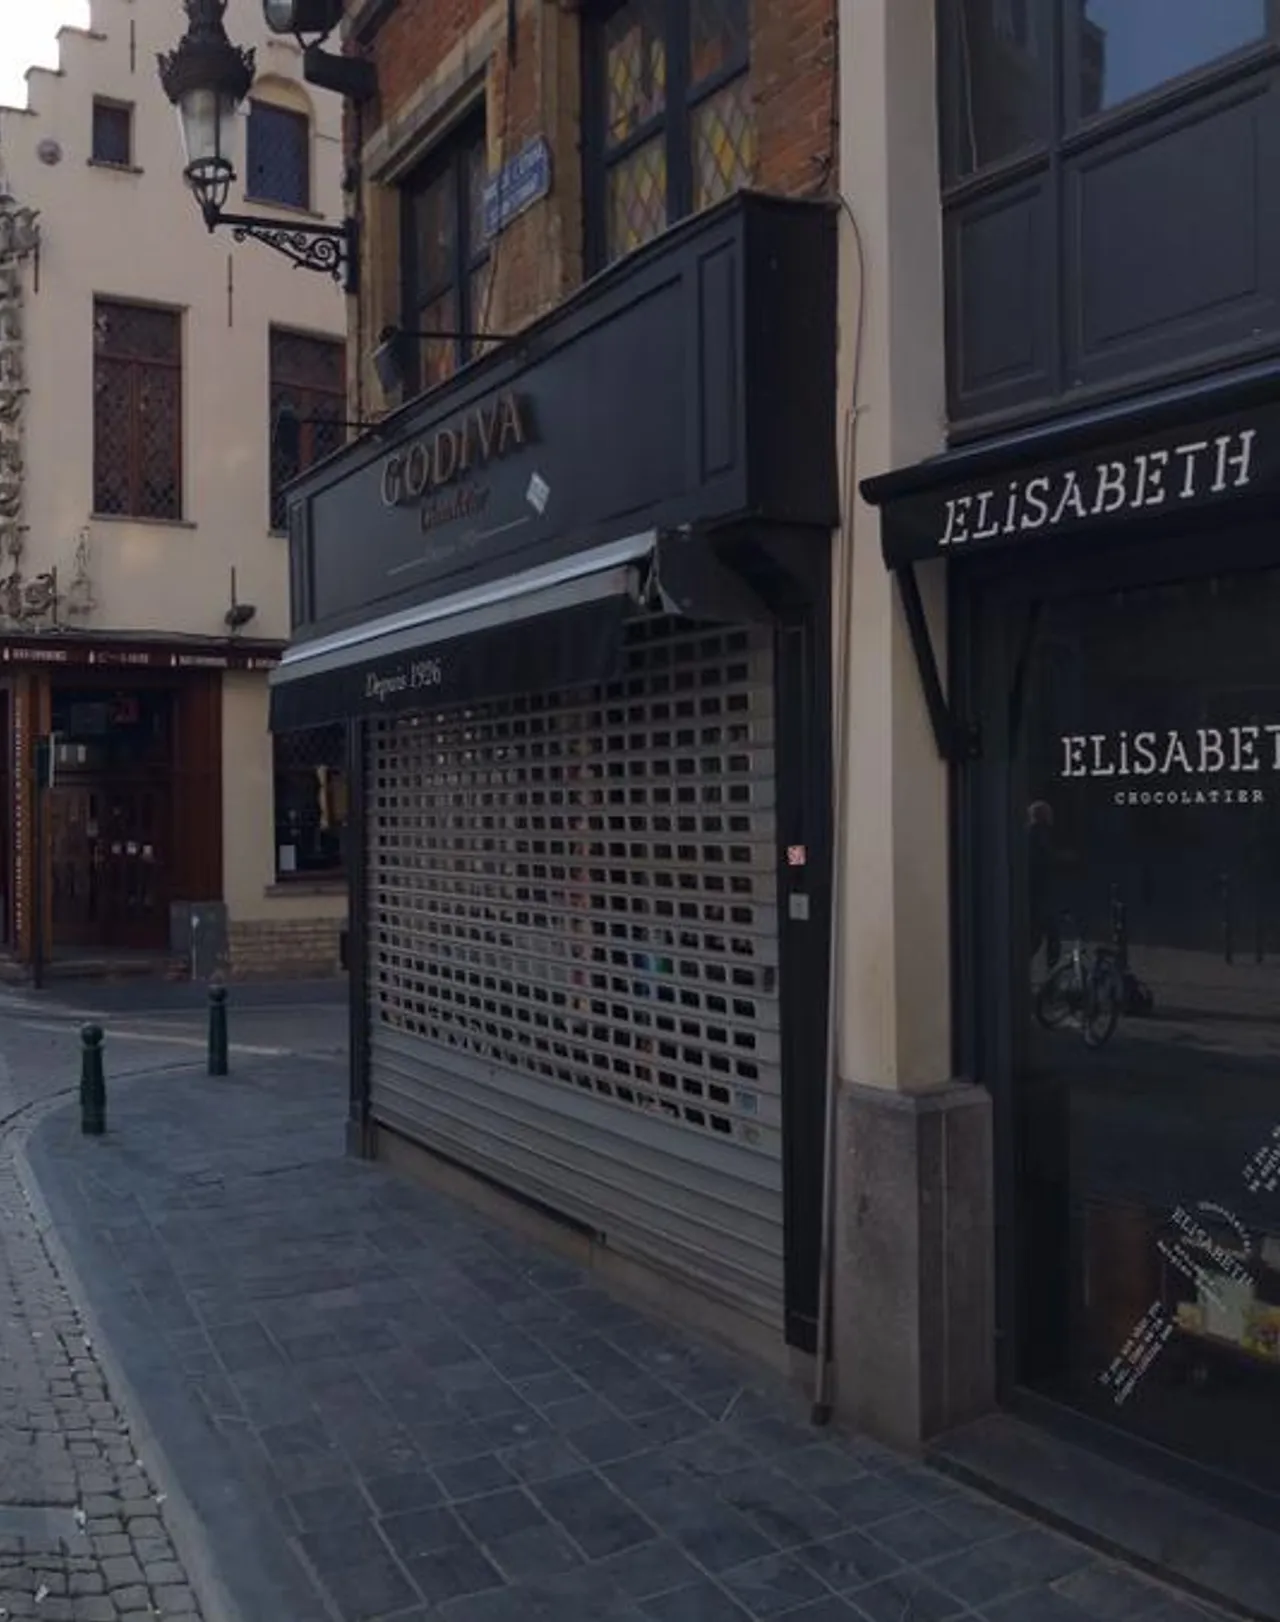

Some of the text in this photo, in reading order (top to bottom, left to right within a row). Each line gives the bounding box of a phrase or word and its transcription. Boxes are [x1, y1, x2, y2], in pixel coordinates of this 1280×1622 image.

[380, 389, 524, 507] GODIVA
[938, 429, 1256, 545] ELiSABETH
[1113, 789, 1264, 804] CHOCOLATIER
